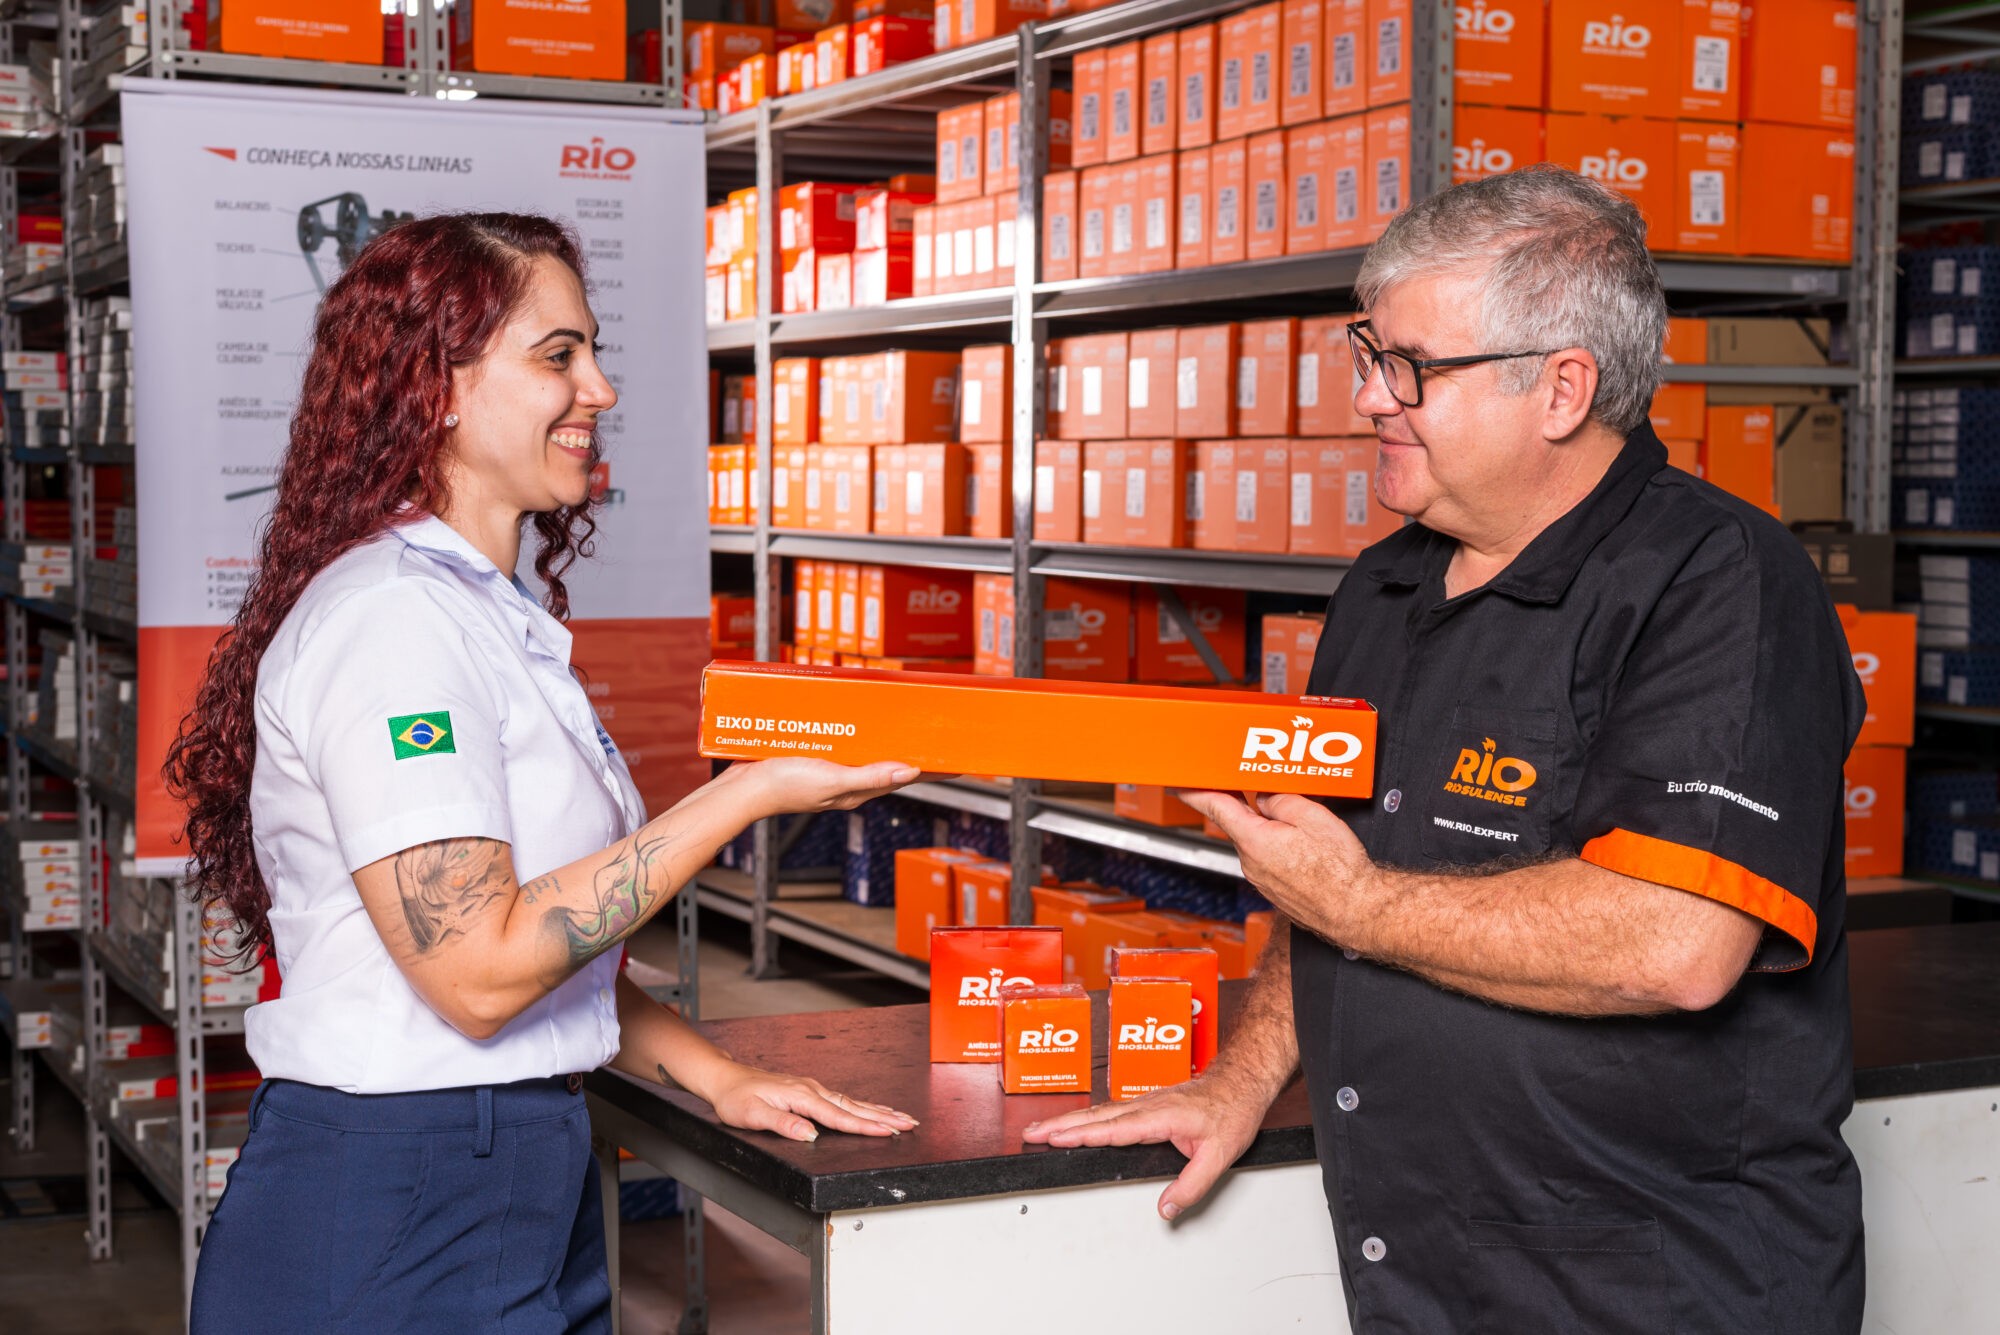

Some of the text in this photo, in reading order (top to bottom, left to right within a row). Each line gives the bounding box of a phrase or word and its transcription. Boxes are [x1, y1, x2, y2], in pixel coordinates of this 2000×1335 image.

[1583, 14, 1652, 48] RIO
[246, 147, 473, 173] CONHEÇA NOSSAS LINHAS
[560, 137, 636, 171] RIO
[1579, 148, 1648, 181] RIO
[716, 716, 856, 737] EIXO DE COMANDO
[1242, 715, 1362, 764] RIO
[715, 736, 761, 747] Camshaft
[798, 741, 810, 749] de
[811, 741, 833, 751] leva
[1239, 762, 1354, 777] RIOSULENSE
[1451, 737, 1537, 792] RIO
[1443, 781, 1527, 807] RIOSULENSE
[1667, 780, 1780, 821] Eu crio movimento
[1434, 816, 1519, 842] WWW.RIO.EXPERT
[958, 999, 999, 1007] RIOSUL
[1019, 1023, 1079, 1048] RIO
[1118, 1017, 1186, 1043] RIO
[1118, 1043, 1182, 1051] RIOSULENSE
